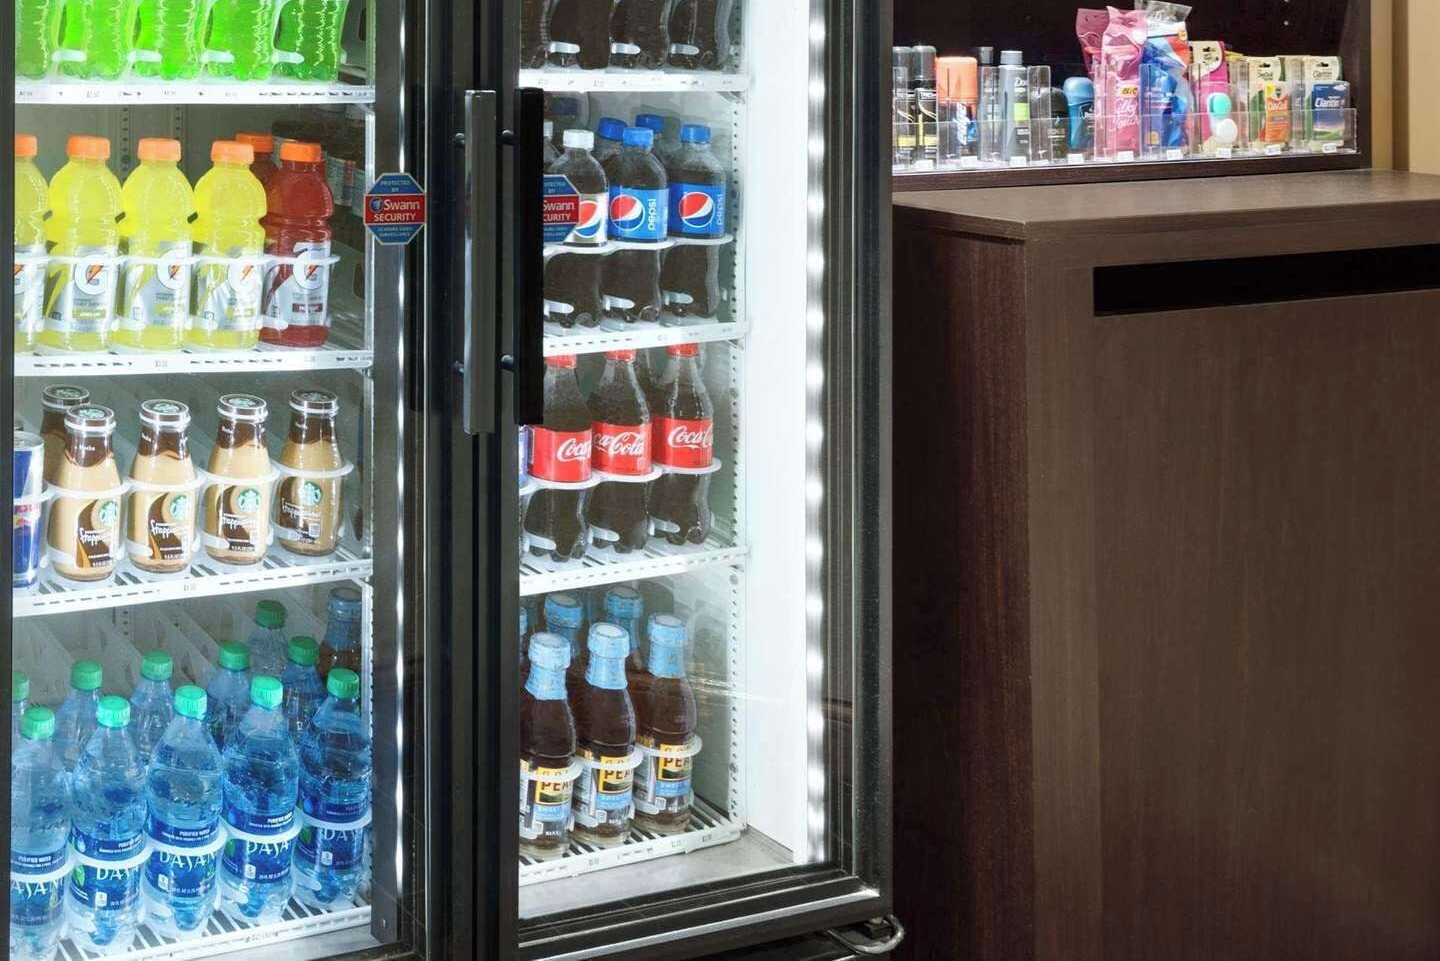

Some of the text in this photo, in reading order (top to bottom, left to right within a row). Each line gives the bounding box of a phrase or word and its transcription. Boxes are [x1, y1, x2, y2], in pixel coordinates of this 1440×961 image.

[384, 199, 420, 210] Swann
[374, 213, 416, 222] SECURITY
[543, 213, 572, 222] CURITY
[648, 198, 657, 231] pepsi
